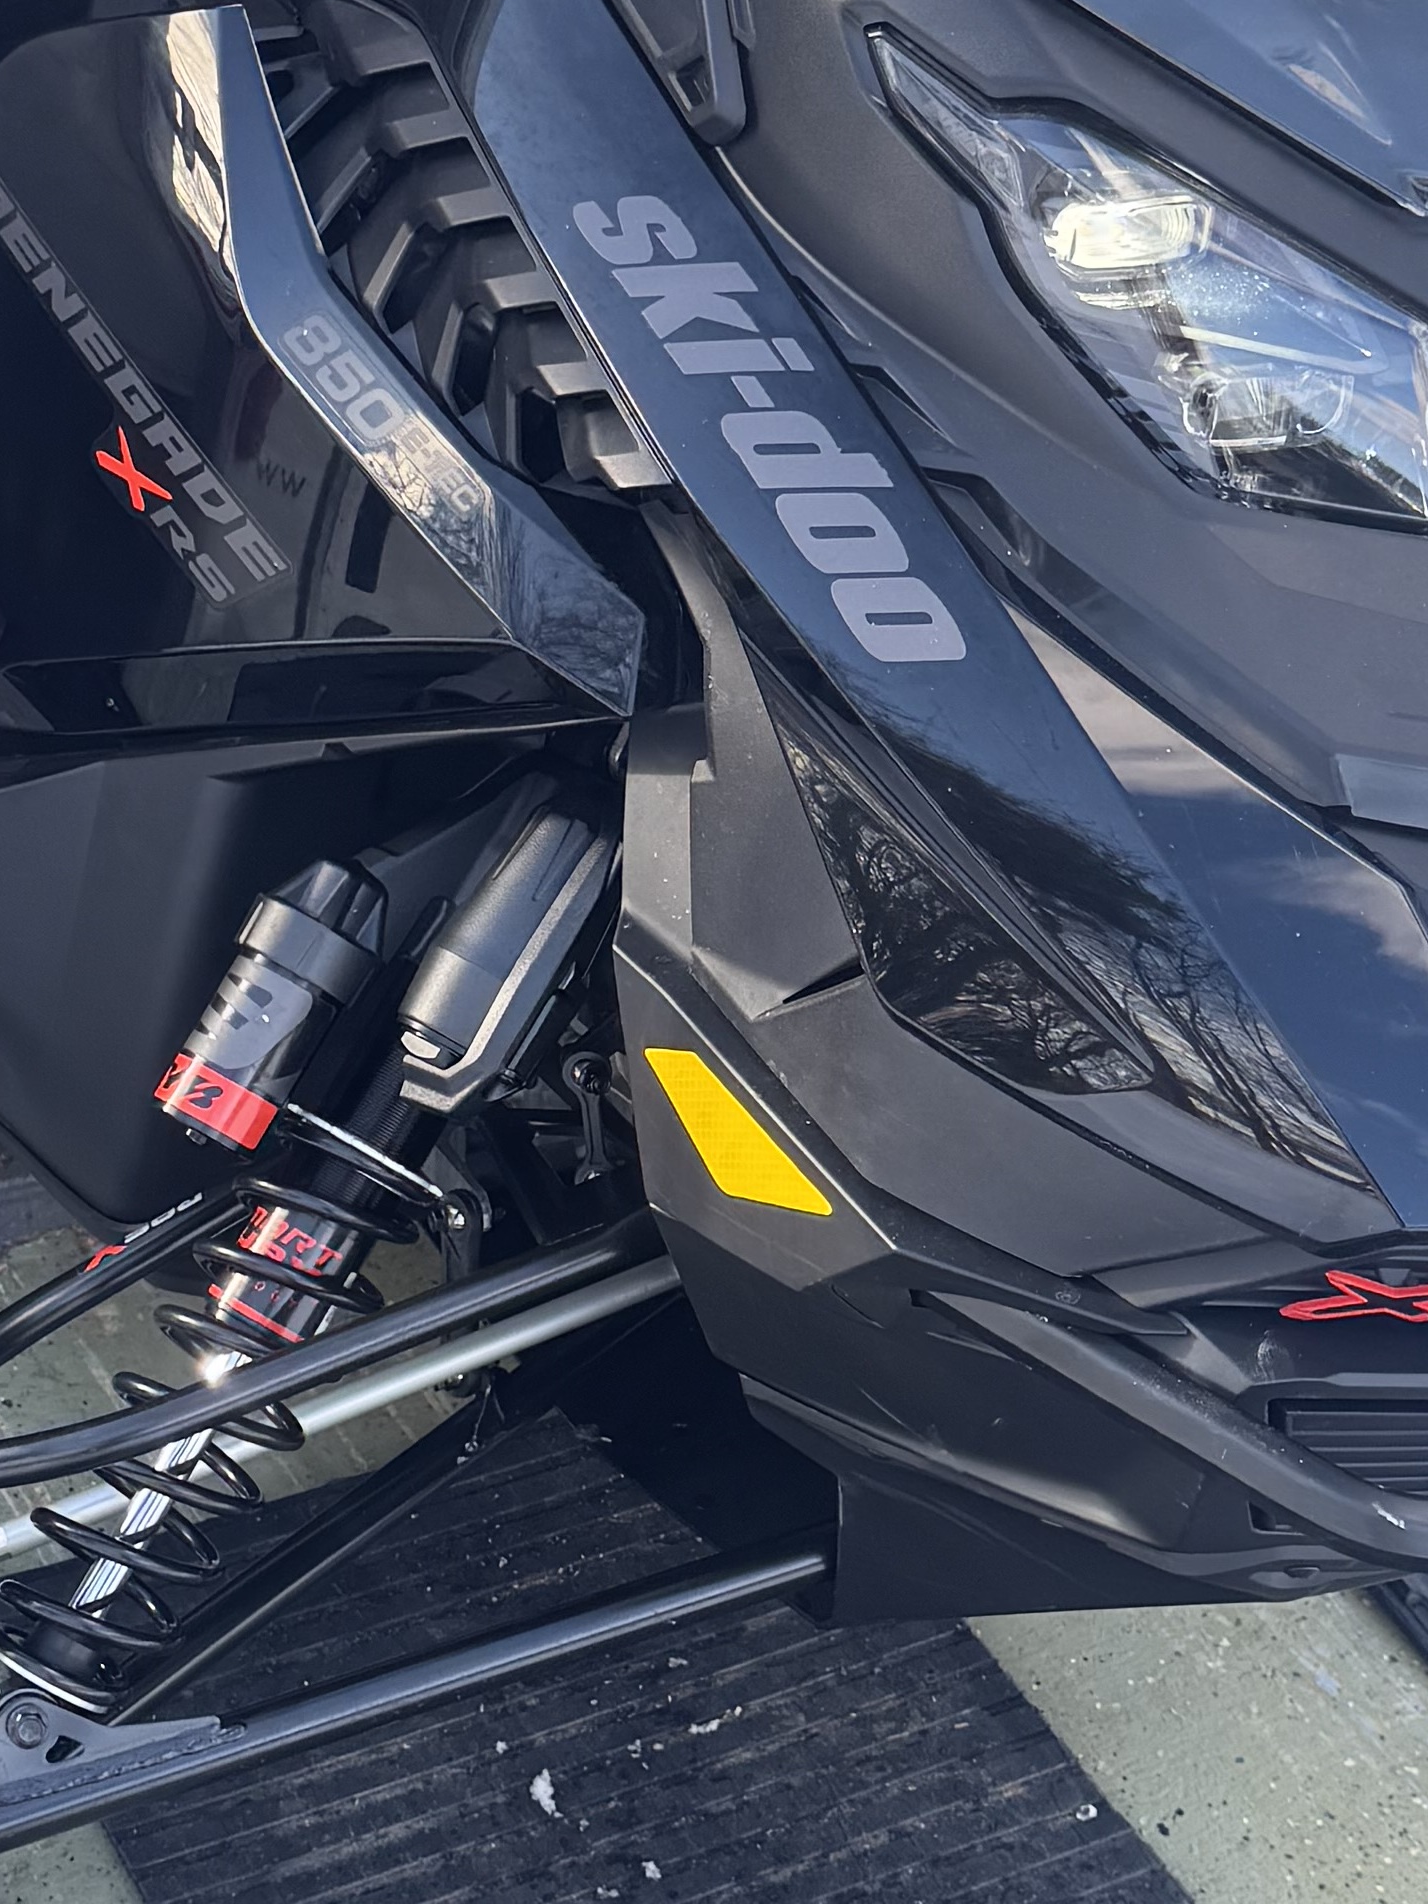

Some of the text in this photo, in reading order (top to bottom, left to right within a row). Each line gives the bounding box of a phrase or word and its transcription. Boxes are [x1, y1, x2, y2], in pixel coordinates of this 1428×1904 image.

[283, 314, 481, 513] 850 E-TEC
[573, 196, 966, 662] ski-doo
